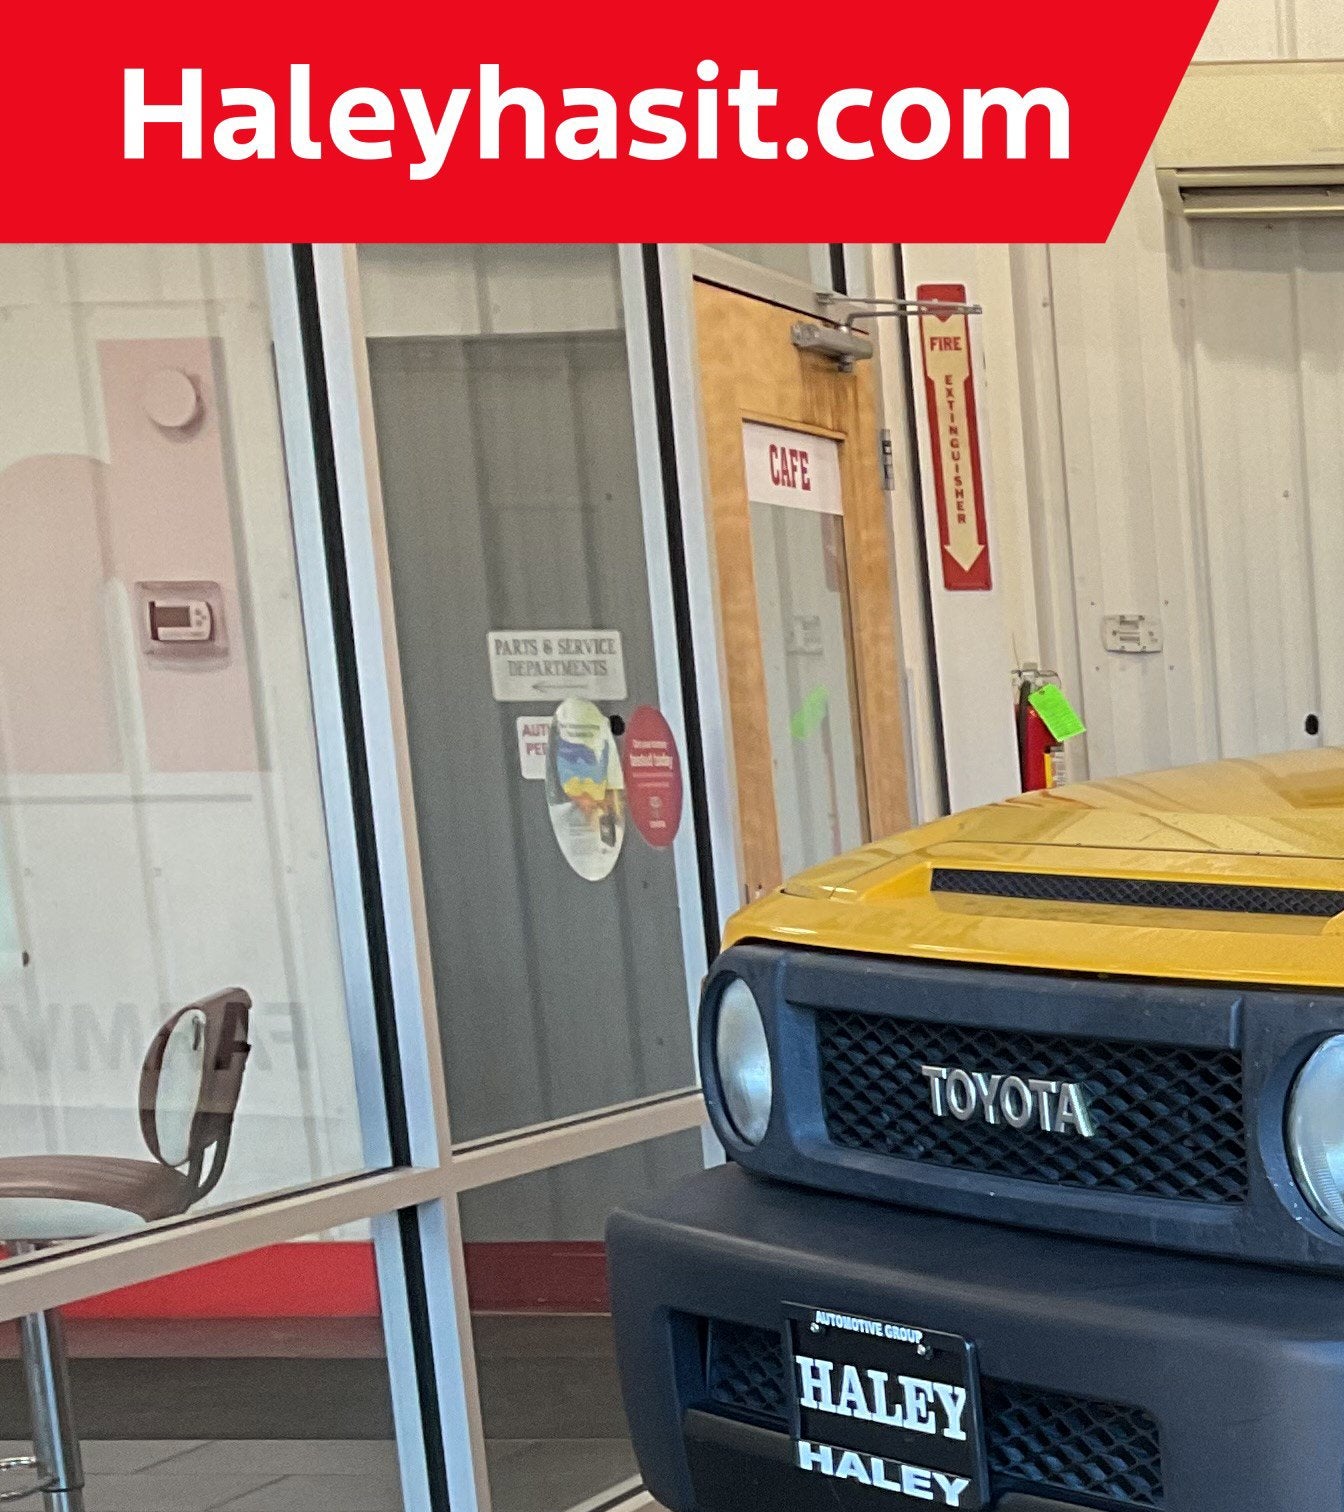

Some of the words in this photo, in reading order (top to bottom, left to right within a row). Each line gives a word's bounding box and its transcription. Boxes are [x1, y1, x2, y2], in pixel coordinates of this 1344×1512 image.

[930, 336, 963, 351] FIRE
[769, 444, 811, 491] CAFE
[944, 374, 966, 524] EXTINGUISHER
[494, 639, 538, 656] PARTS
[558, 638, 618, 655] SERVICE
[507, 660, 608, 677] DEPARTMENTS
[922, 1065, 1095, 1137] TOYOTA
[816, 1311, 883, 1337] AUTOMOTIVE
[884, 1325, 923, 1343] GROUP
[796, 1355, 967, 1441] HALEY
[798, 1440, 970, 1507] HALEY
